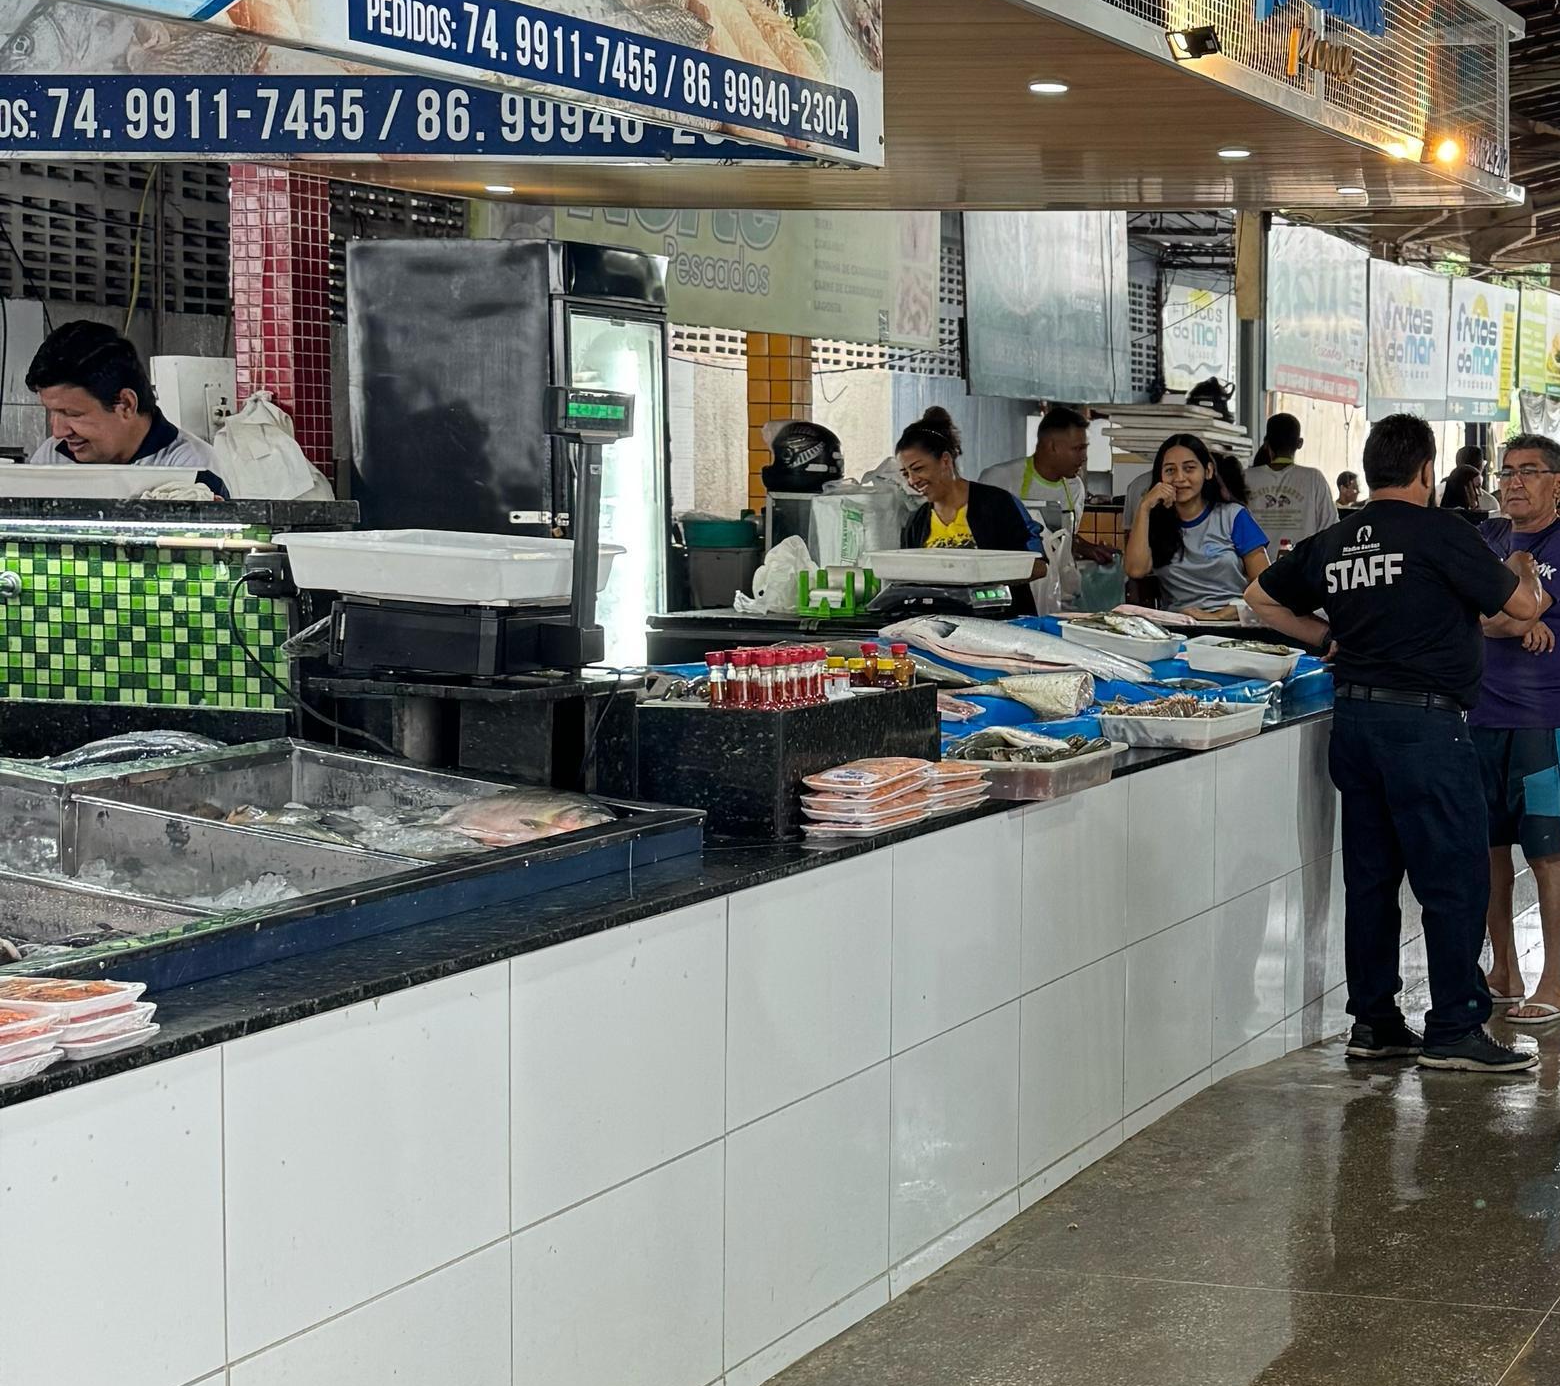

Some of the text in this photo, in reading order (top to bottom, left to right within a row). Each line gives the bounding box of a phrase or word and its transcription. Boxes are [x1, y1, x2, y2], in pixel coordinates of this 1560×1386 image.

[463, 2, 508, 61] 74.
[516, 15, 657, 95] 9911-7455
[683, 58, 718, 110] 86.
[724, 68, 848, 140] 99940-2304
[48, 88, 111, 138] 74.
[125, 88, 365, 140] 9911-7455
[416, 88, 485, 142] 86.
[663, 234, 770, 296] Pescados
[1457, 302, 1498, 347] frutos
[1325, 553, 1404, 593] STAFF
